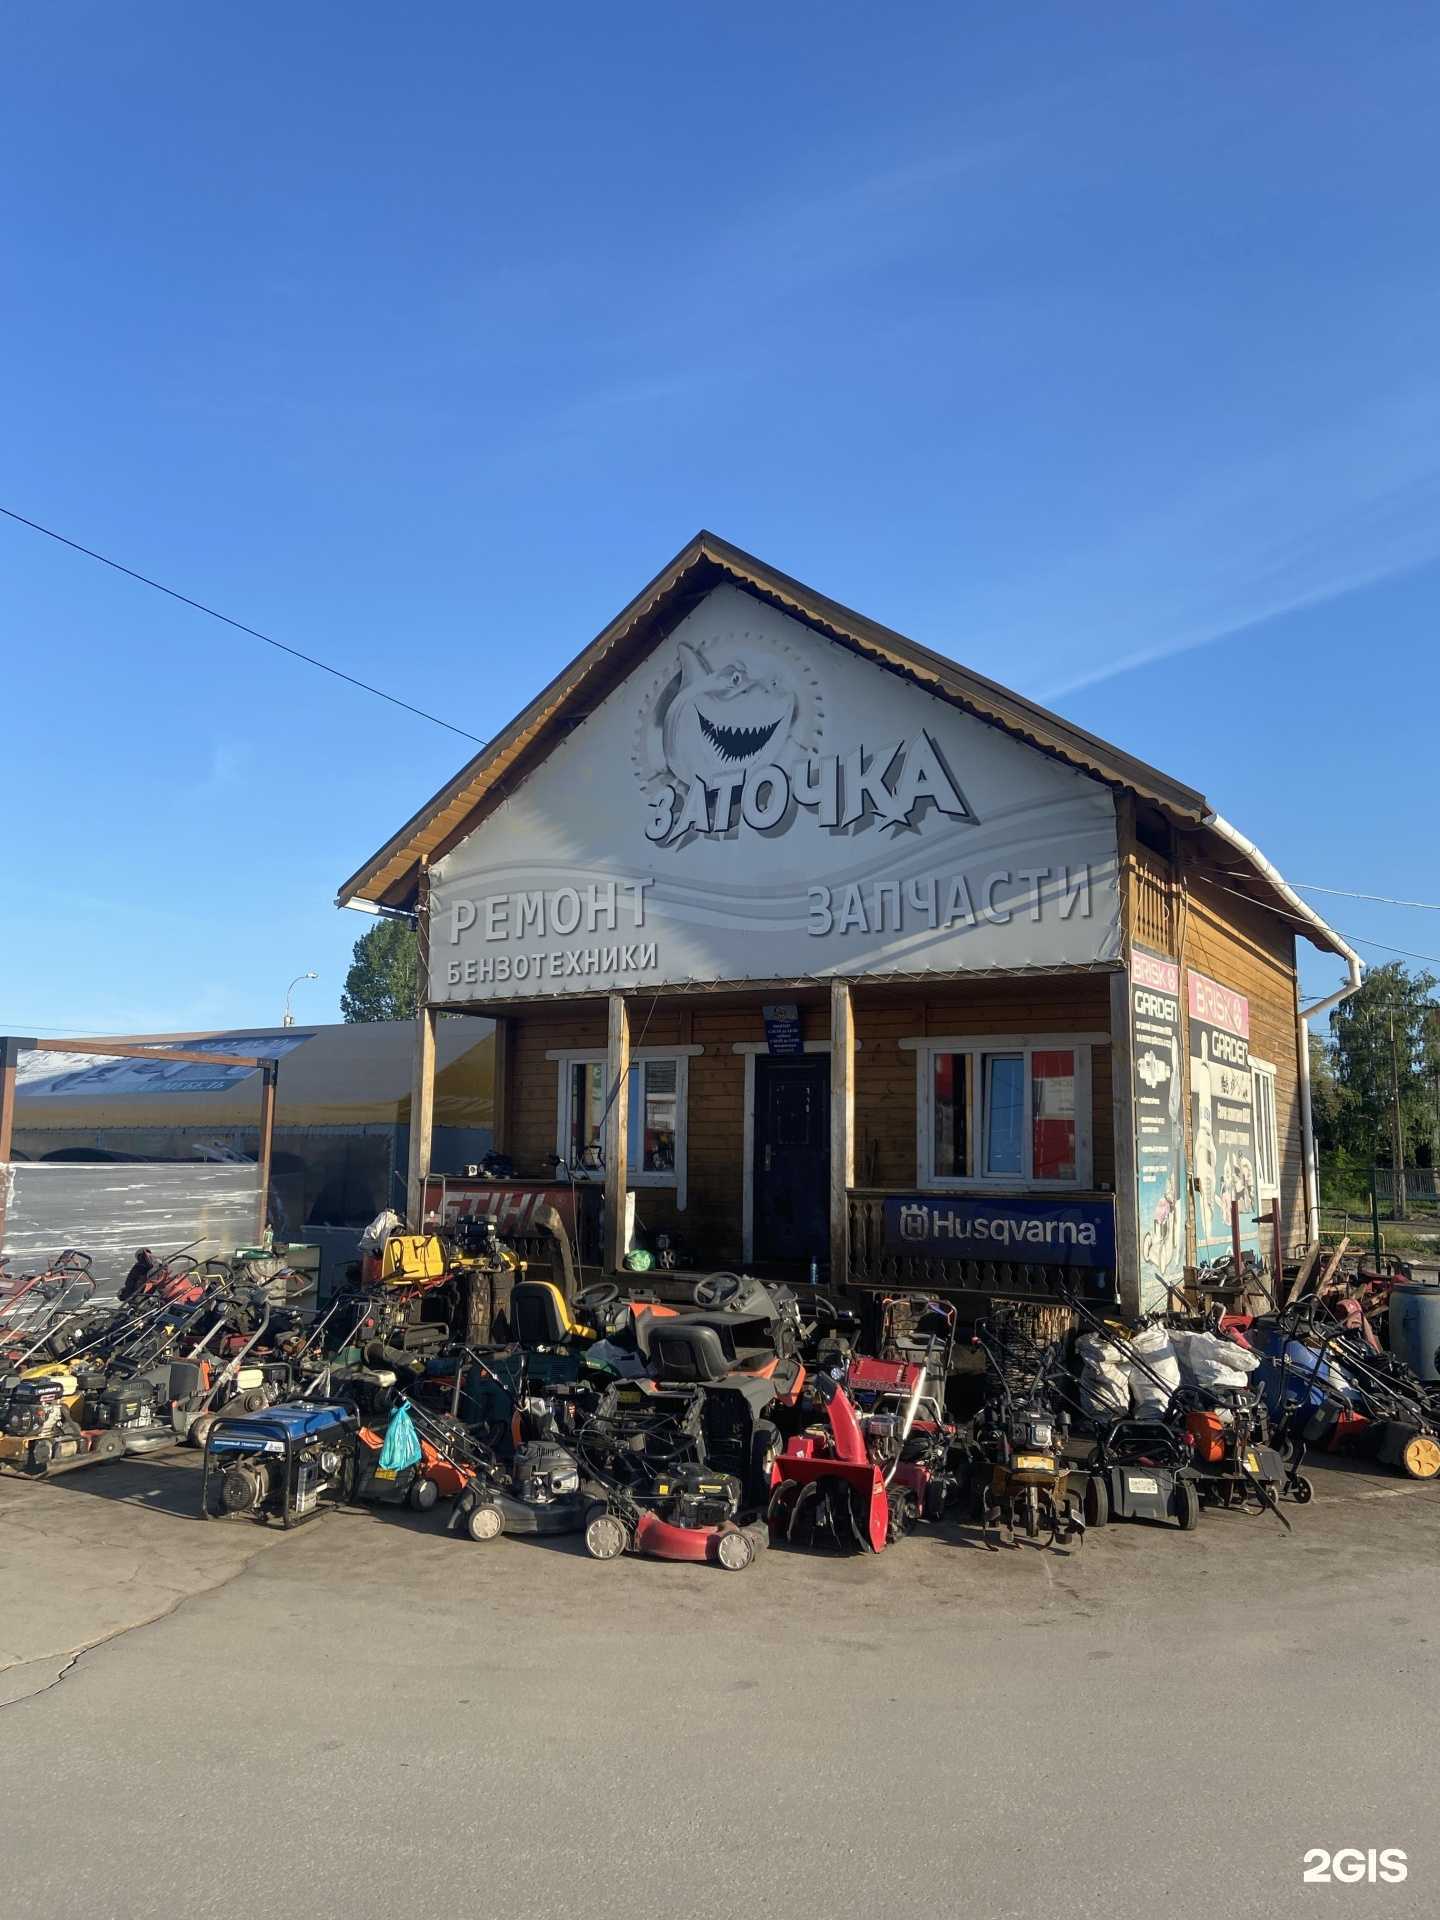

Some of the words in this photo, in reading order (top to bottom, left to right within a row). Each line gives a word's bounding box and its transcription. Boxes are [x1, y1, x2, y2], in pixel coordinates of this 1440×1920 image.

[645, 728, 971, 845] ЗАТОЧКА
[451, 878, 655, 944] РЕМОНТ
[807, 863, 1091, 936] ЗАПЧАСТИ
[448, 942, 658, 984] БЕНЗОТЕХНИКИ
[932, 1210, 1098, 1246] Husqvarna
